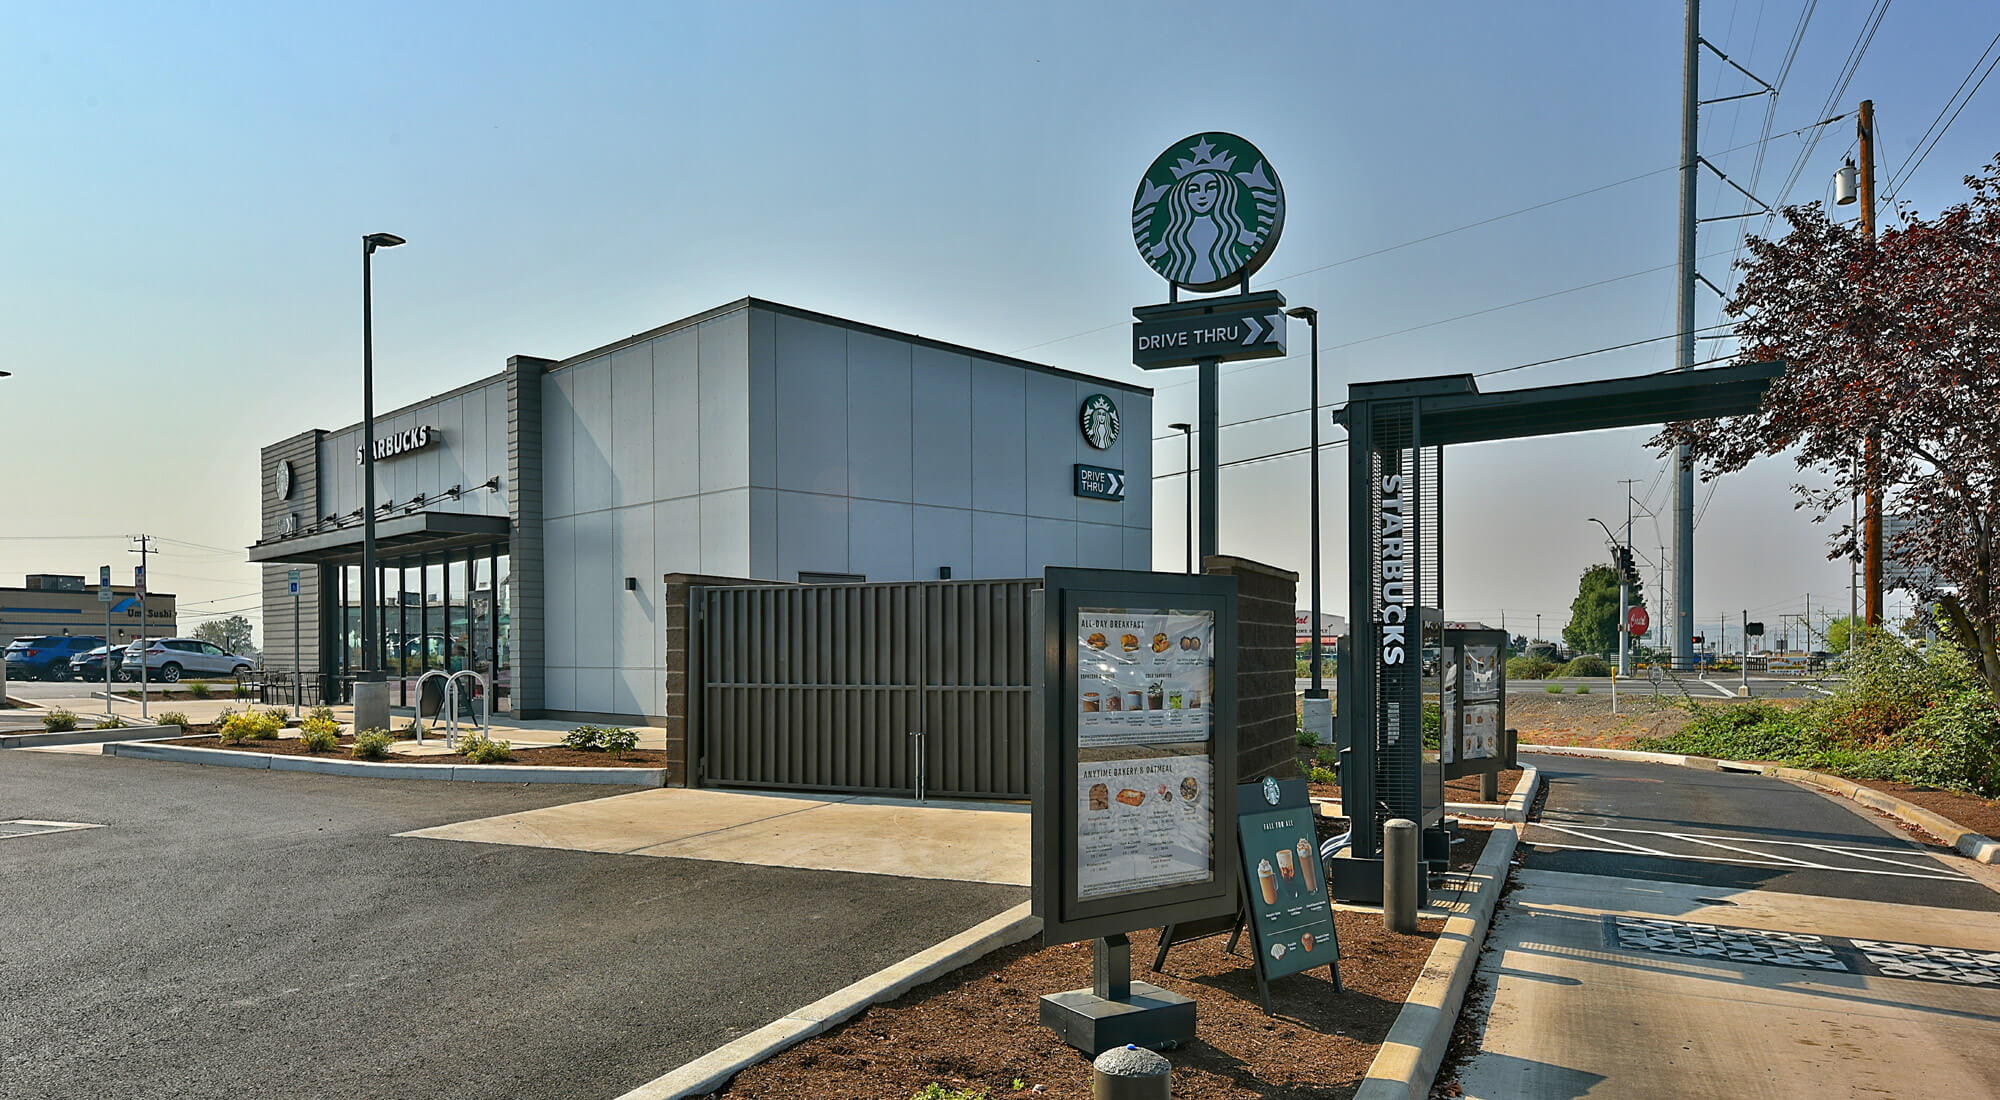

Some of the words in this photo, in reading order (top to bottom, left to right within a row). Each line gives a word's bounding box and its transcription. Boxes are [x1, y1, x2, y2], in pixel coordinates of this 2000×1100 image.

[1138, 331, 1188, 351] DRIVE
[1193, 326, 1239, 344] THRU
[356, 425, 428, 466] SARBUCKS
[1081, 469, 1105, 483] DRIVE
[1081, 480, 1104, 493] THRU
[1381, 473, 1406, 666] STARBUCKS
[127, 609, 142, 618] Um
[147, 608, 172, 618] Sushi
[1081, 619, 1108, 628] ALL-DAY
[1109, 620, 1145, 629] BREAKFAST
[1083, 769, 1112, 779] ANYTIME
[1113, 767, 1138, 777] BAKERY
[1145, 765, 1173, 775] OATMEAL
